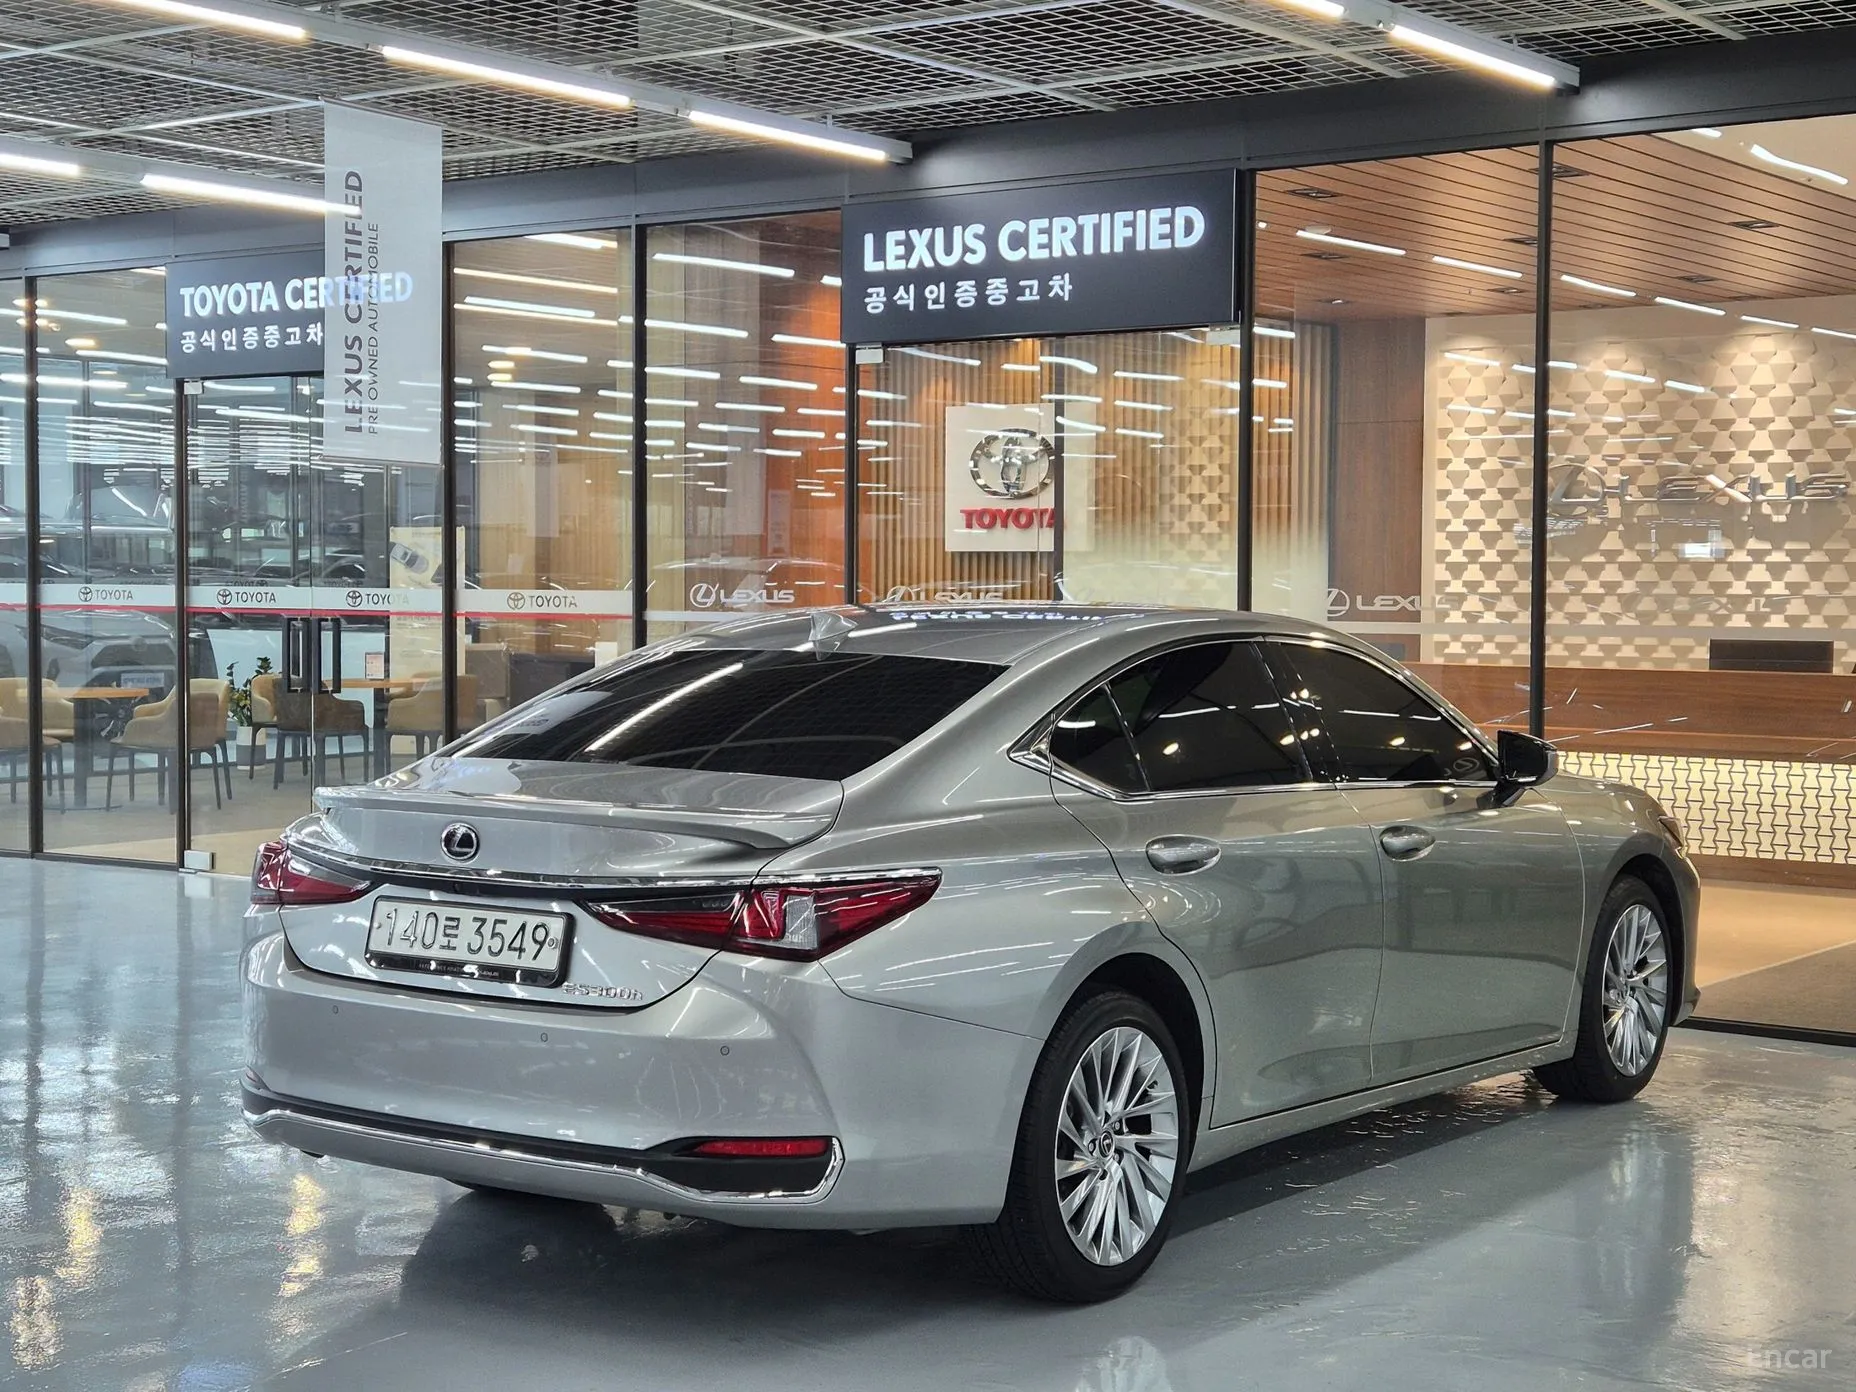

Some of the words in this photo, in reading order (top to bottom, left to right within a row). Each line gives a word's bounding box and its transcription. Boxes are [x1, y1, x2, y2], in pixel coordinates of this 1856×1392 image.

[863, 223, 988, 273] LEXUS
[997, 205, 1206, 263] CERTIFIED
[367, 223, 379, 332] AUTOMOBILE
[180, 280, 281, 317] TOYOTA
[344, 335, 362, 433] LEXUS
[368, 336, 378, 401] OWNED
[368, 404, 378, 434] PRE
[95, 589, 133, 601] TOYOTA
[235, 591, 277, 603] TOYOTA
[530, 595, 578, 608] TOYOTA
[719, 589, 795, 603] LEXUS
[466, 916, 550, 961] 3549
